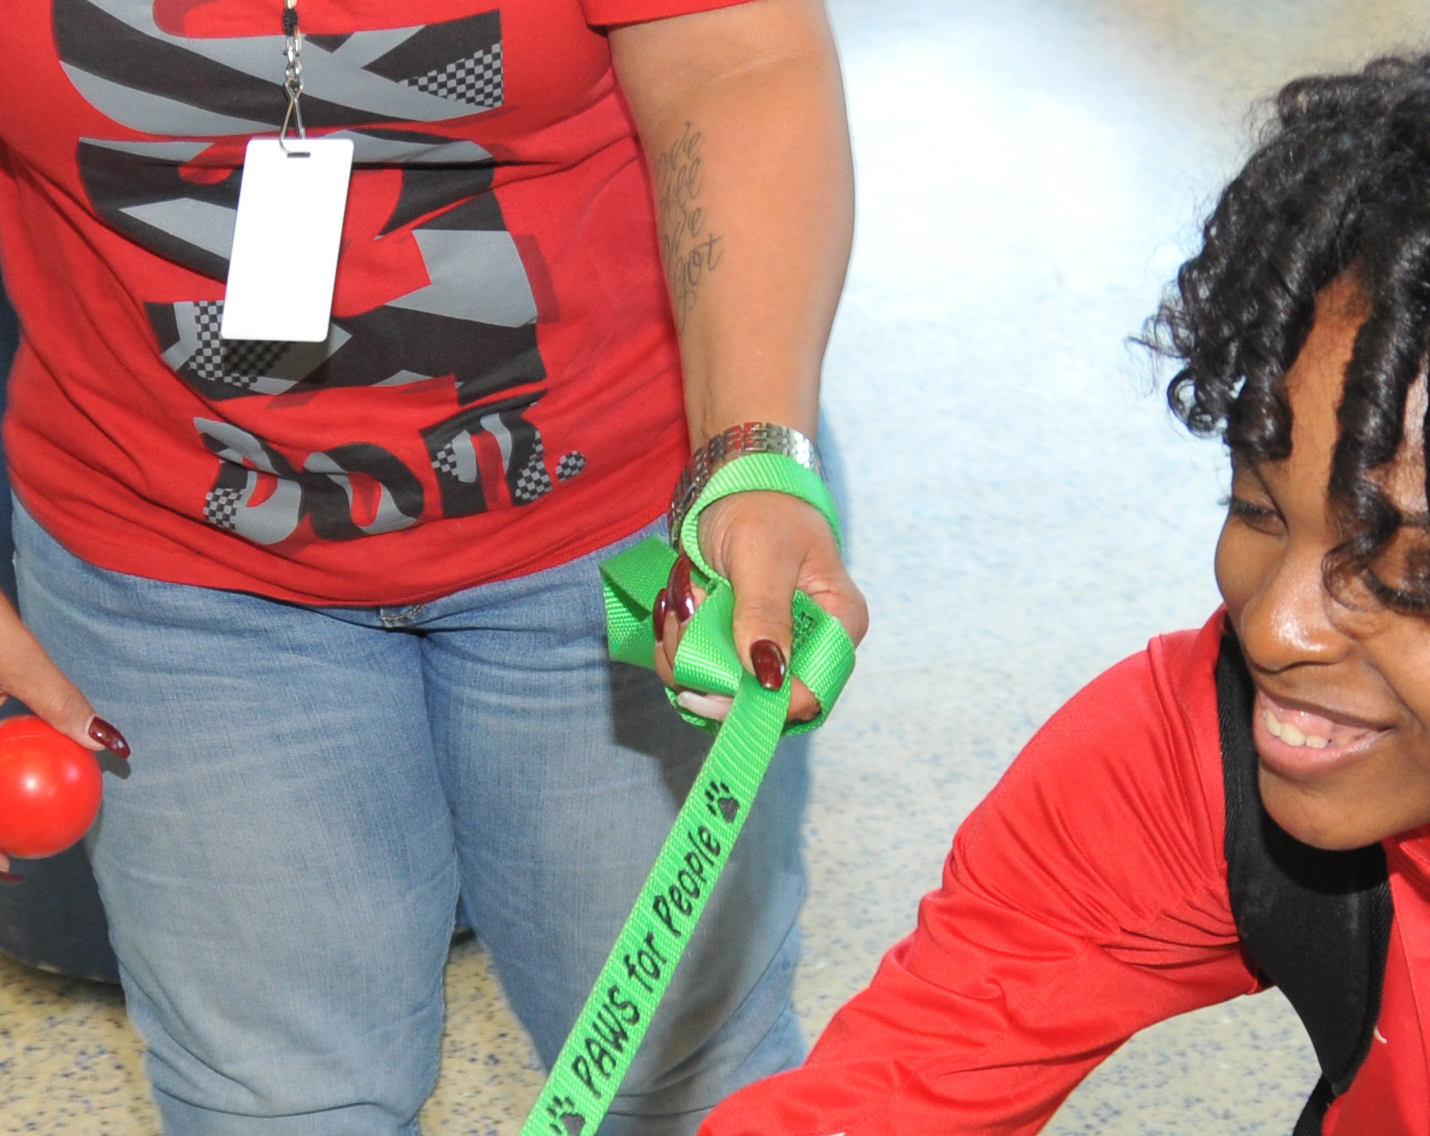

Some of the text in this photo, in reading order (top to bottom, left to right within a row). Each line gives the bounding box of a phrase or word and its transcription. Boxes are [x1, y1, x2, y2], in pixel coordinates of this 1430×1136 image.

[571, 824, 721, 1098] PAWS for People
